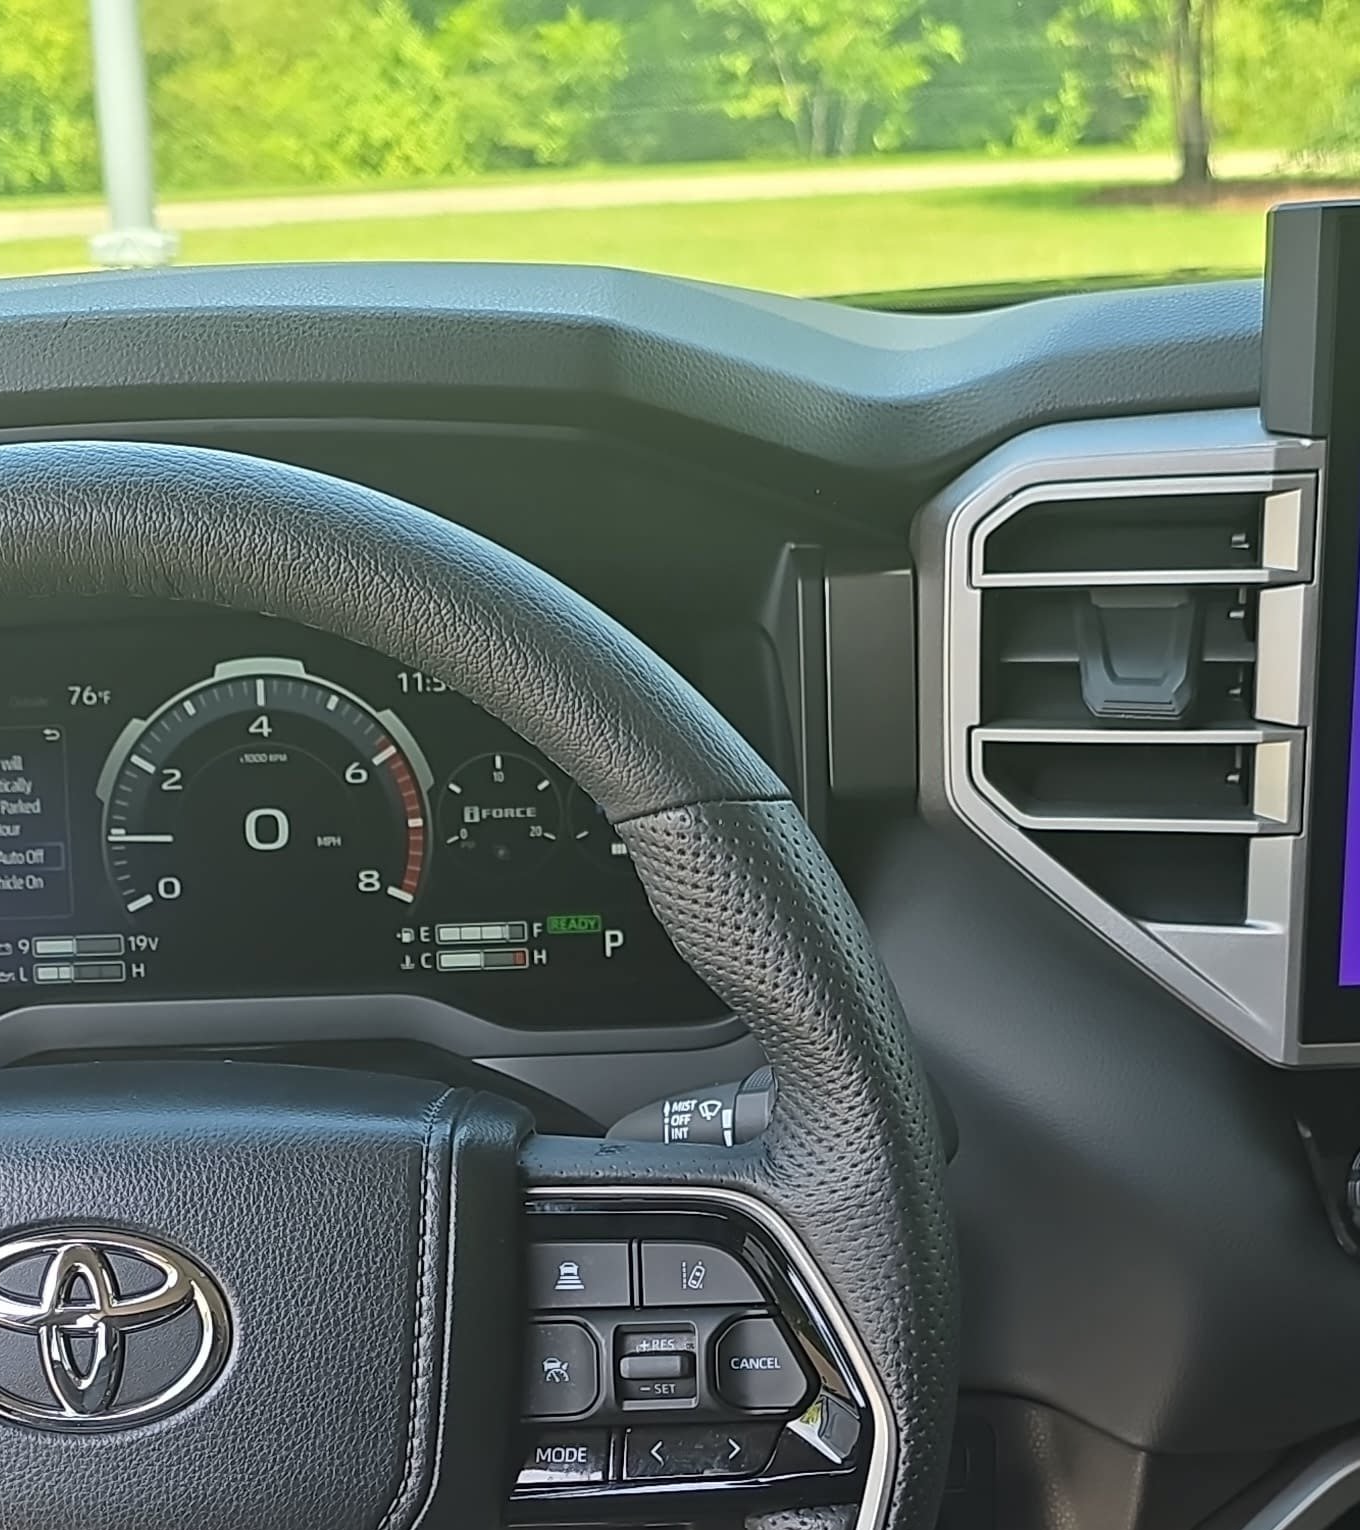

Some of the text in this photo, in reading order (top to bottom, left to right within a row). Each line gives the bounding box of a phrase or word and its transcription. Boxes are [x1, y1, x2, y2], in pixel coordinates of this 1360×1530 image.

[248, 715, 272, 737] 4
[1, 755, 23, 771] will
[161, 768, 183, 790] 2
[345, 762, 368, 783] 6
[493, 771, 505, 782] 10
[1, 798, 41, 815] Parked
[244, 808, 289, 851] 0
[459, 828, 468, 840] 0
[529, 826, 543, 838] 20
[317, 835, 342, 847] MPH
[26, 849, 45, 863] Off
[26, 875, 44, 889] On
[157, 876, 181, 899] 0
[357, 870, 381, 892] 8
[533, 923, 543, 938] F
[550, 917, 598, 930] READY
[420, 927, 431, 942] E
[18, 940, 30, 955] 9
[128, 935, 159, 952] 19V
[604, 930, 624, 957] P
[421, 954, 432, 968] C
[533, 950, 547, 964] H
[19, 967, 28, 982] L
[132, 964, 145, 978] H
[671, 1100, 698, 1112] MIST
[671, 1114, 691, 1126] OFF
[671, 1127, 689, 1139] INT
[730, 1357, 781, 1370] CANCEL
[535, 1446, 588, 1464] MODE
